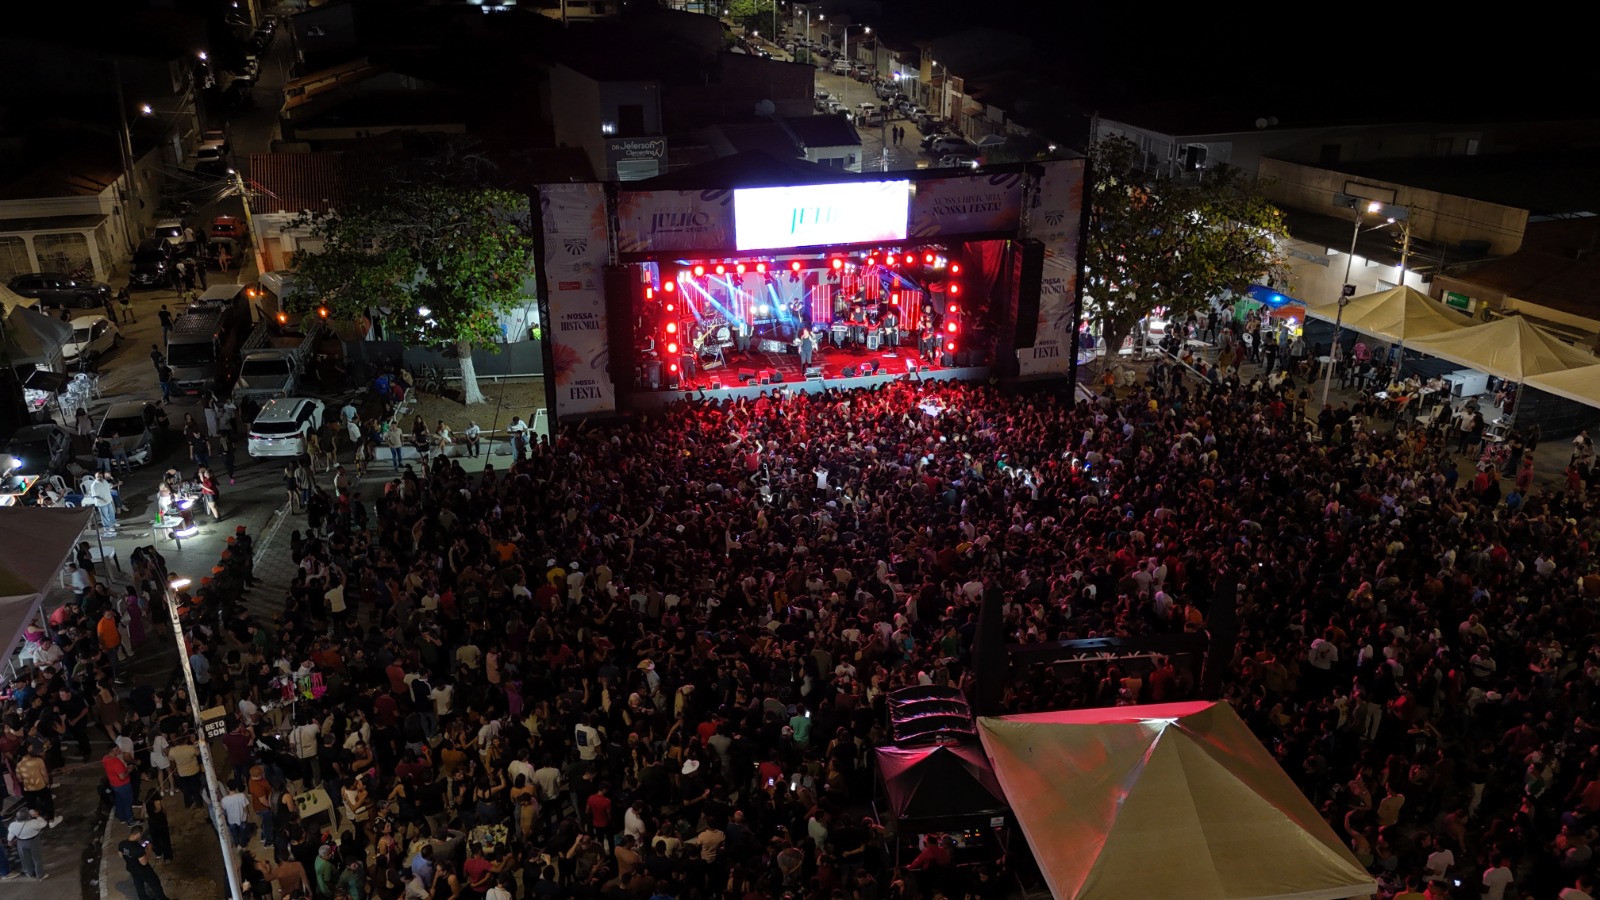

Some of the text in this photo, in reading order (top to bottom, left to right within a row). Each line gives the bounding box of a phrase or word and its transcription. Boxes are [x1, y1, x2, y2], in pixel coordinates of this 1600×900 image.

[620, 140, 655, 150] Jeferson
[567, 312, 593, 320] NOSSA
[1033, 345, 1059, 359] FESTA
[570, 386, 602, 400] FESTA
[205, 720, 225, 731] BETO
